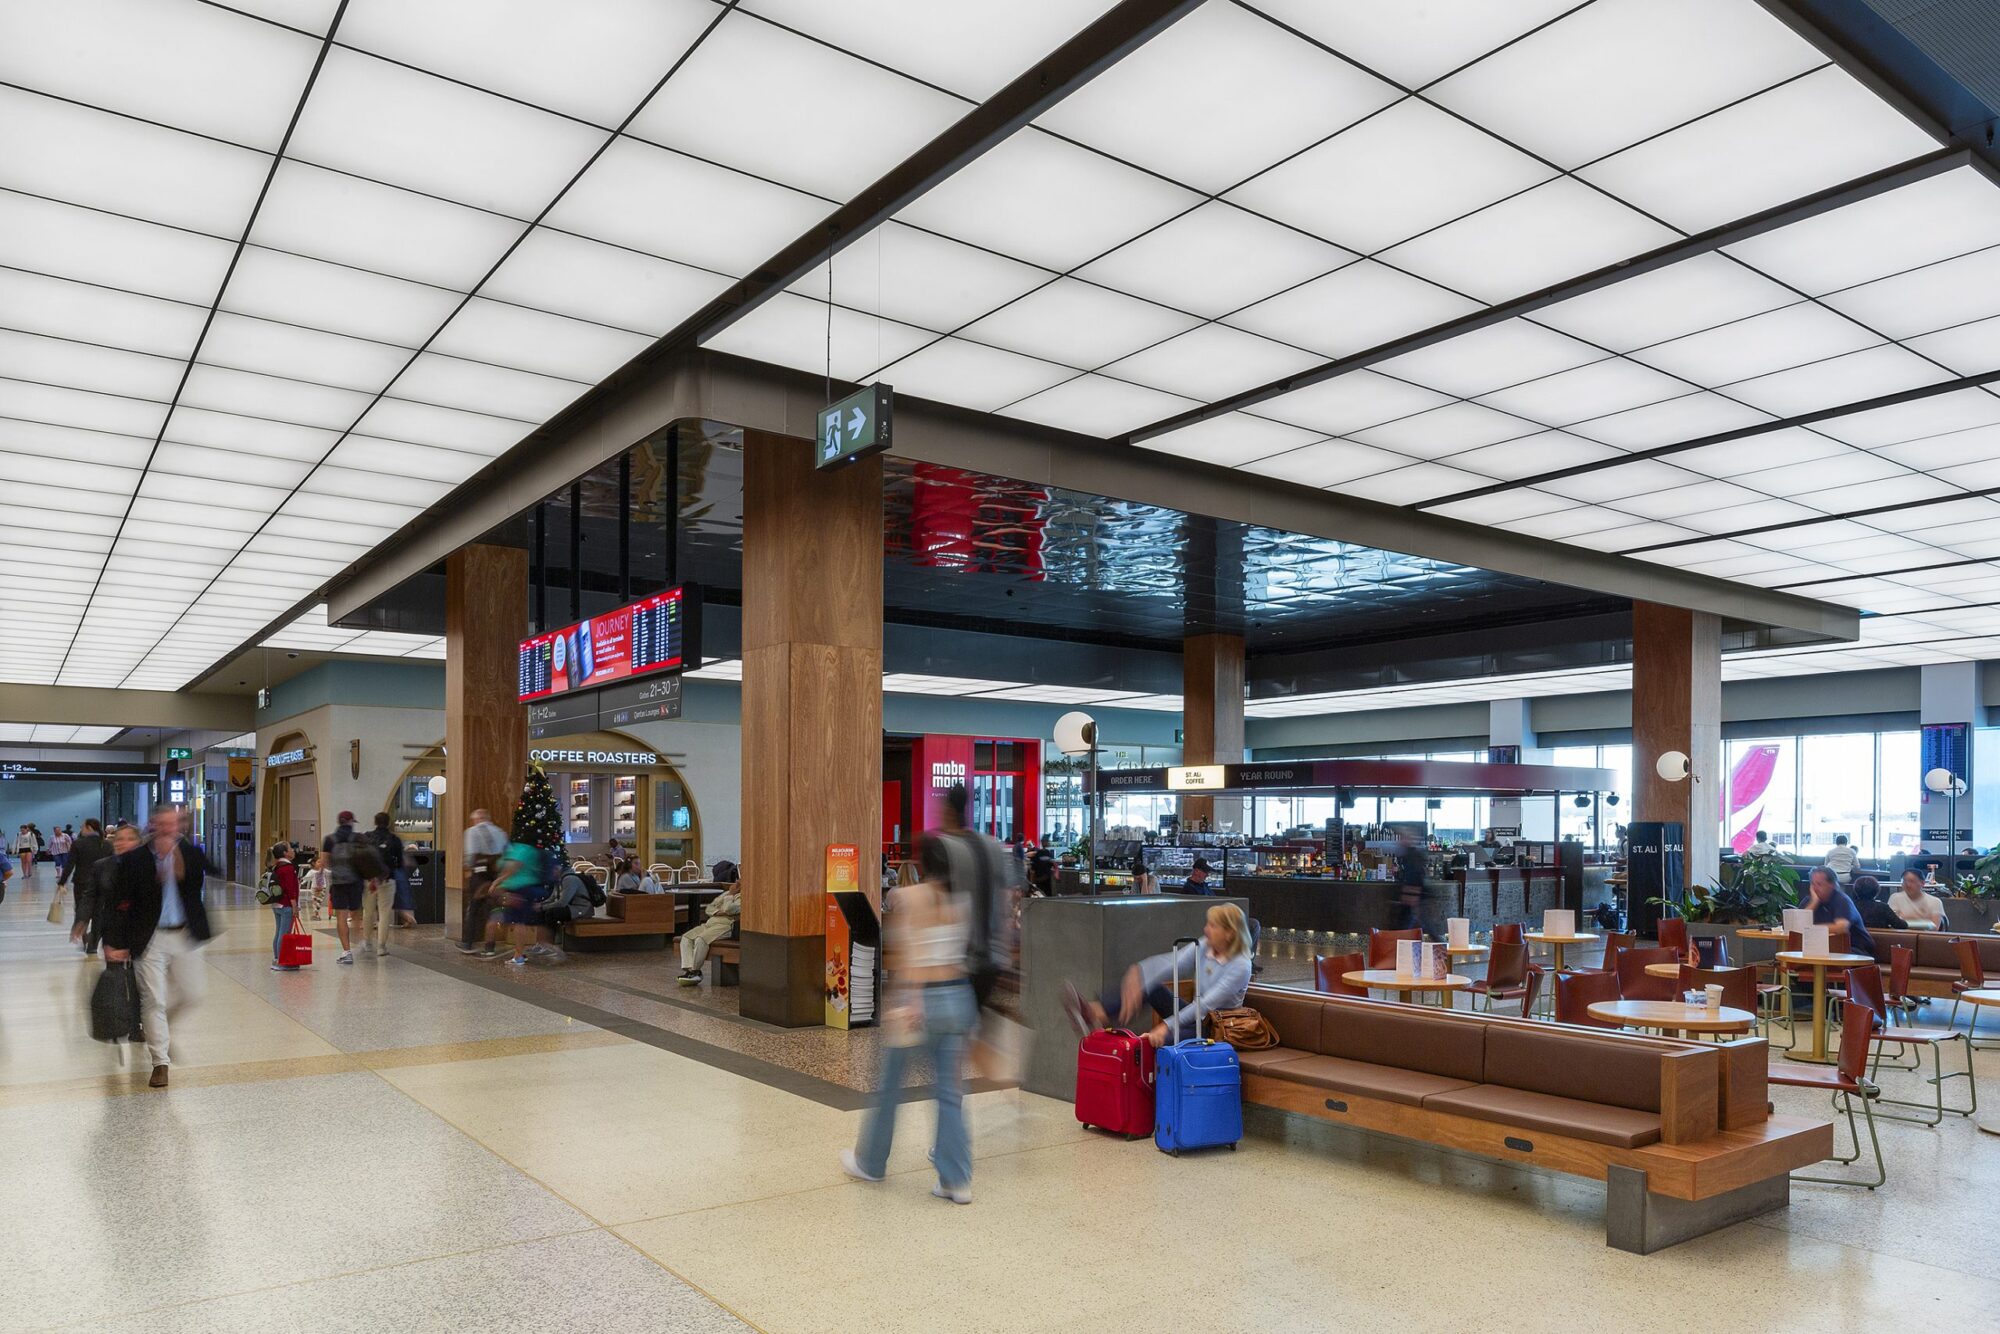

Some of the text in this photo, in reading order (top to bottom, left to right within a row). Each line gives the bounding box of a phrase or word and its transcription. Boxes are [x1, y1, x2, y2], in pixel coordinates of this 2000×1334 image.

[595, 613, 630, 638] JOURNEY
[530, 749, 657, 764] COFFEE ROASTERS
[932, 760, 965, 775] mobo
[1110, 775, 1152, 785] ORDER HERE
[1240, 770, 1294, 781] YEAR ROUND
